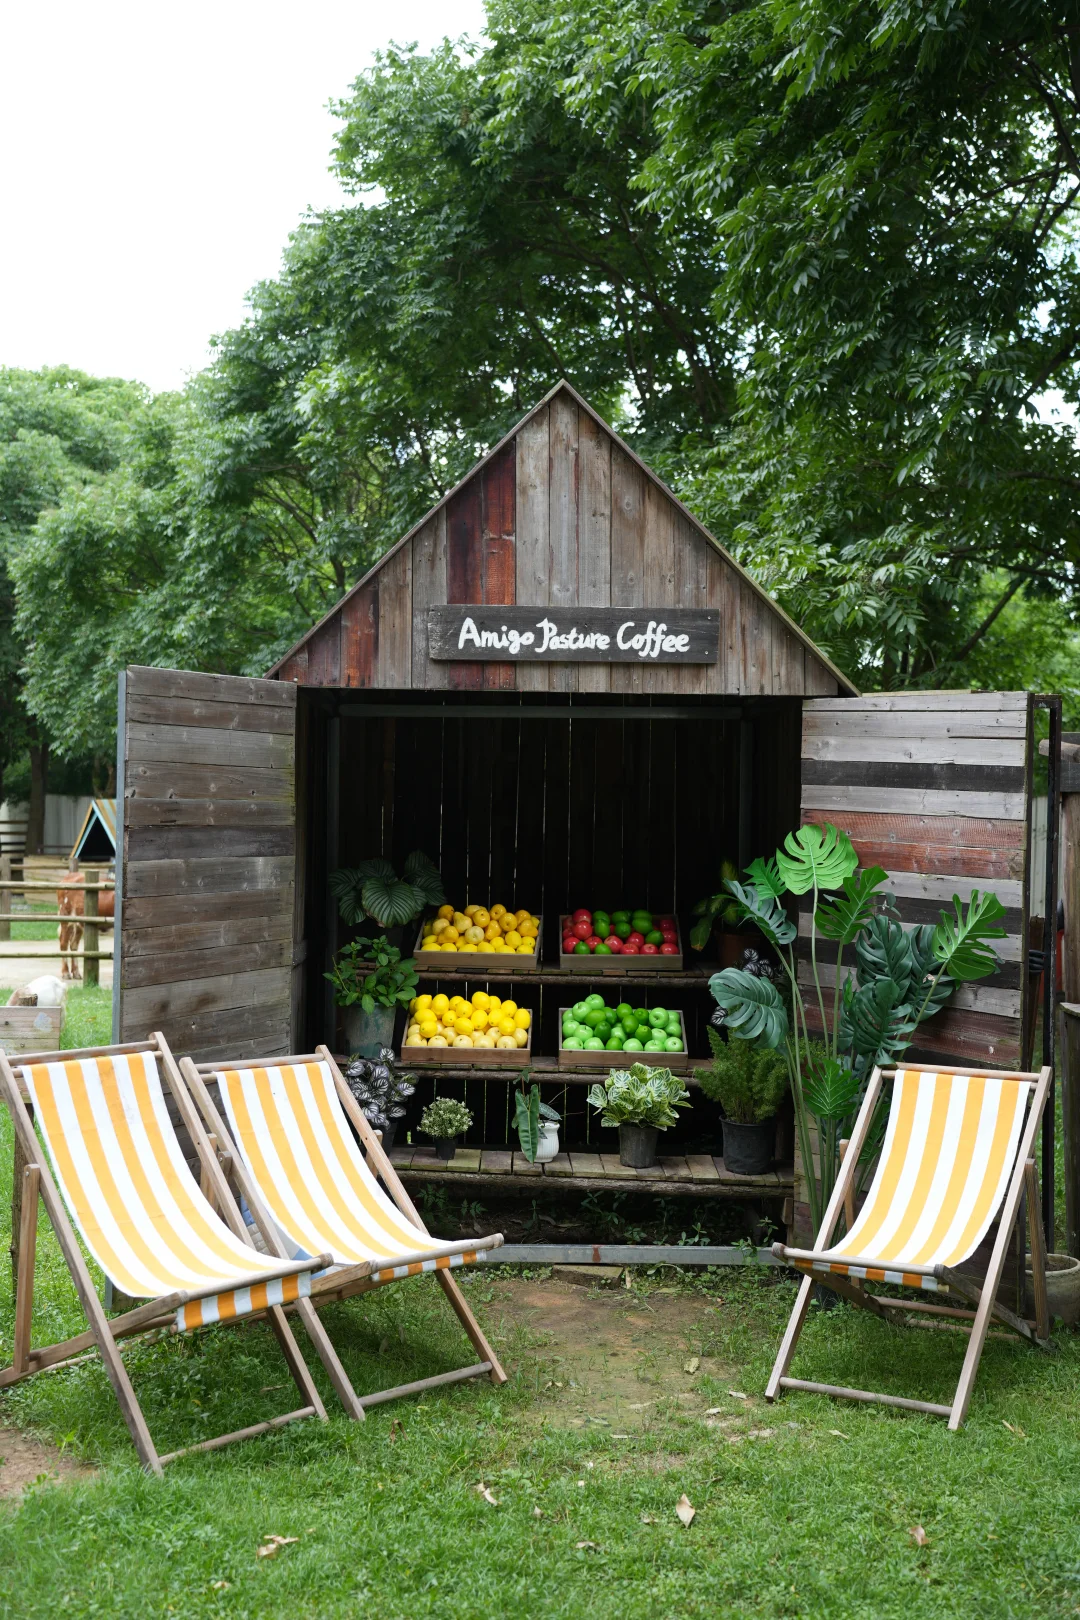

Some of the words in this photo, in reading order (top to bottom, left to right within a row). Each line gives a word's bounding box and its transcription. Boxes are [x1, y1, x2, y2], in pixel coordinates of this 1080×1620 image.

[458, 616, 534, 655] Amigo
[535, 617, 610, 653] Pasture
[616, 620, 690, 658] Coffee
